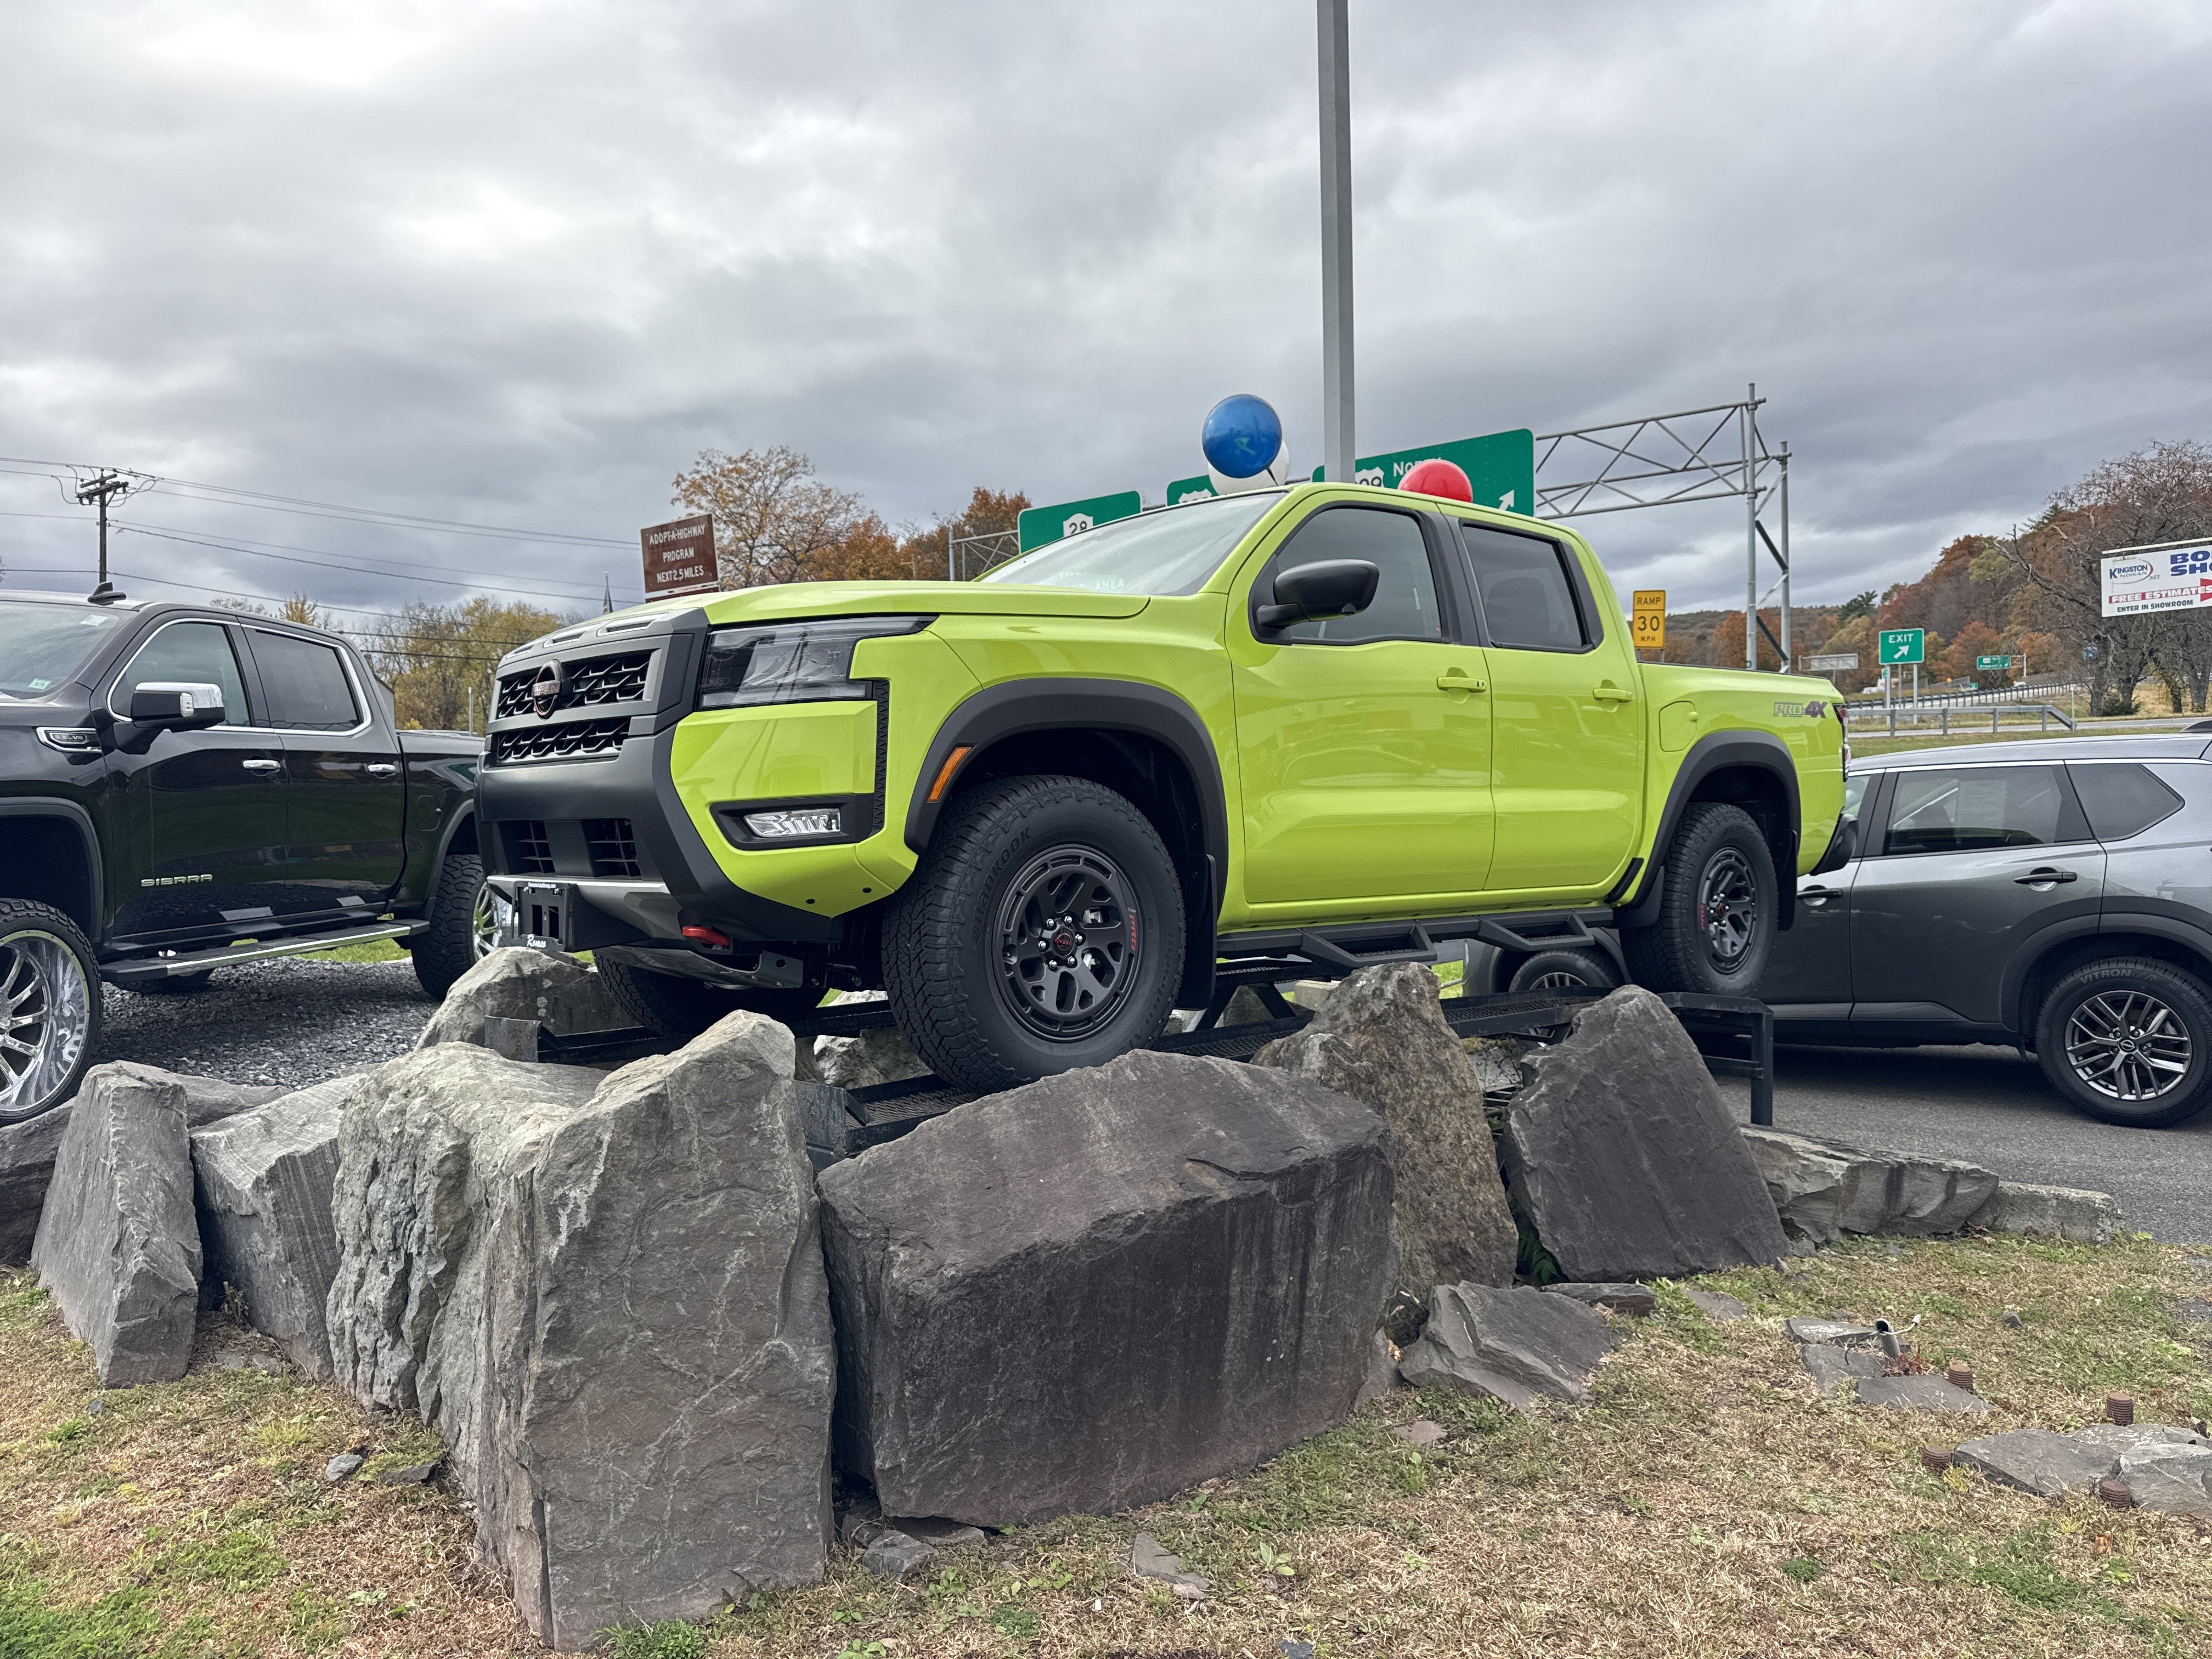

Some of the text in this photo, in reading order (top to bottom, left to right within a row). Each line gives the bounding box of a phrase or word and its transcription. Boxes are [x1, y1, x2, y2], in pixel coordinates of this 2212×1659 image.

[662, 546, 695, 563] PROGRAM
[2170, 550, 2212, 565] BO
[656, 565, 704, 583] NEXT 2.5 MILES
[2109, 564, 2148, 579] KINGSTON
[2170, 562, 2212, 577] SH
[1637, 596, 1661, 606] RAMP
[2112, 585, 2212, 603] FREE ESTIMATES
[2117, 605, 2140, 613] ENTER
[2151, 599, 2193, 610] SHOWROOM
[1637, 615, 1660, 631] 30
[1888, 633, 1914, 644] EXIT
[140, 873, 213, 887] SIERRA
[526, 934, 546, 949] Romeo
[2079, 969, 2132, 984] VITRON
